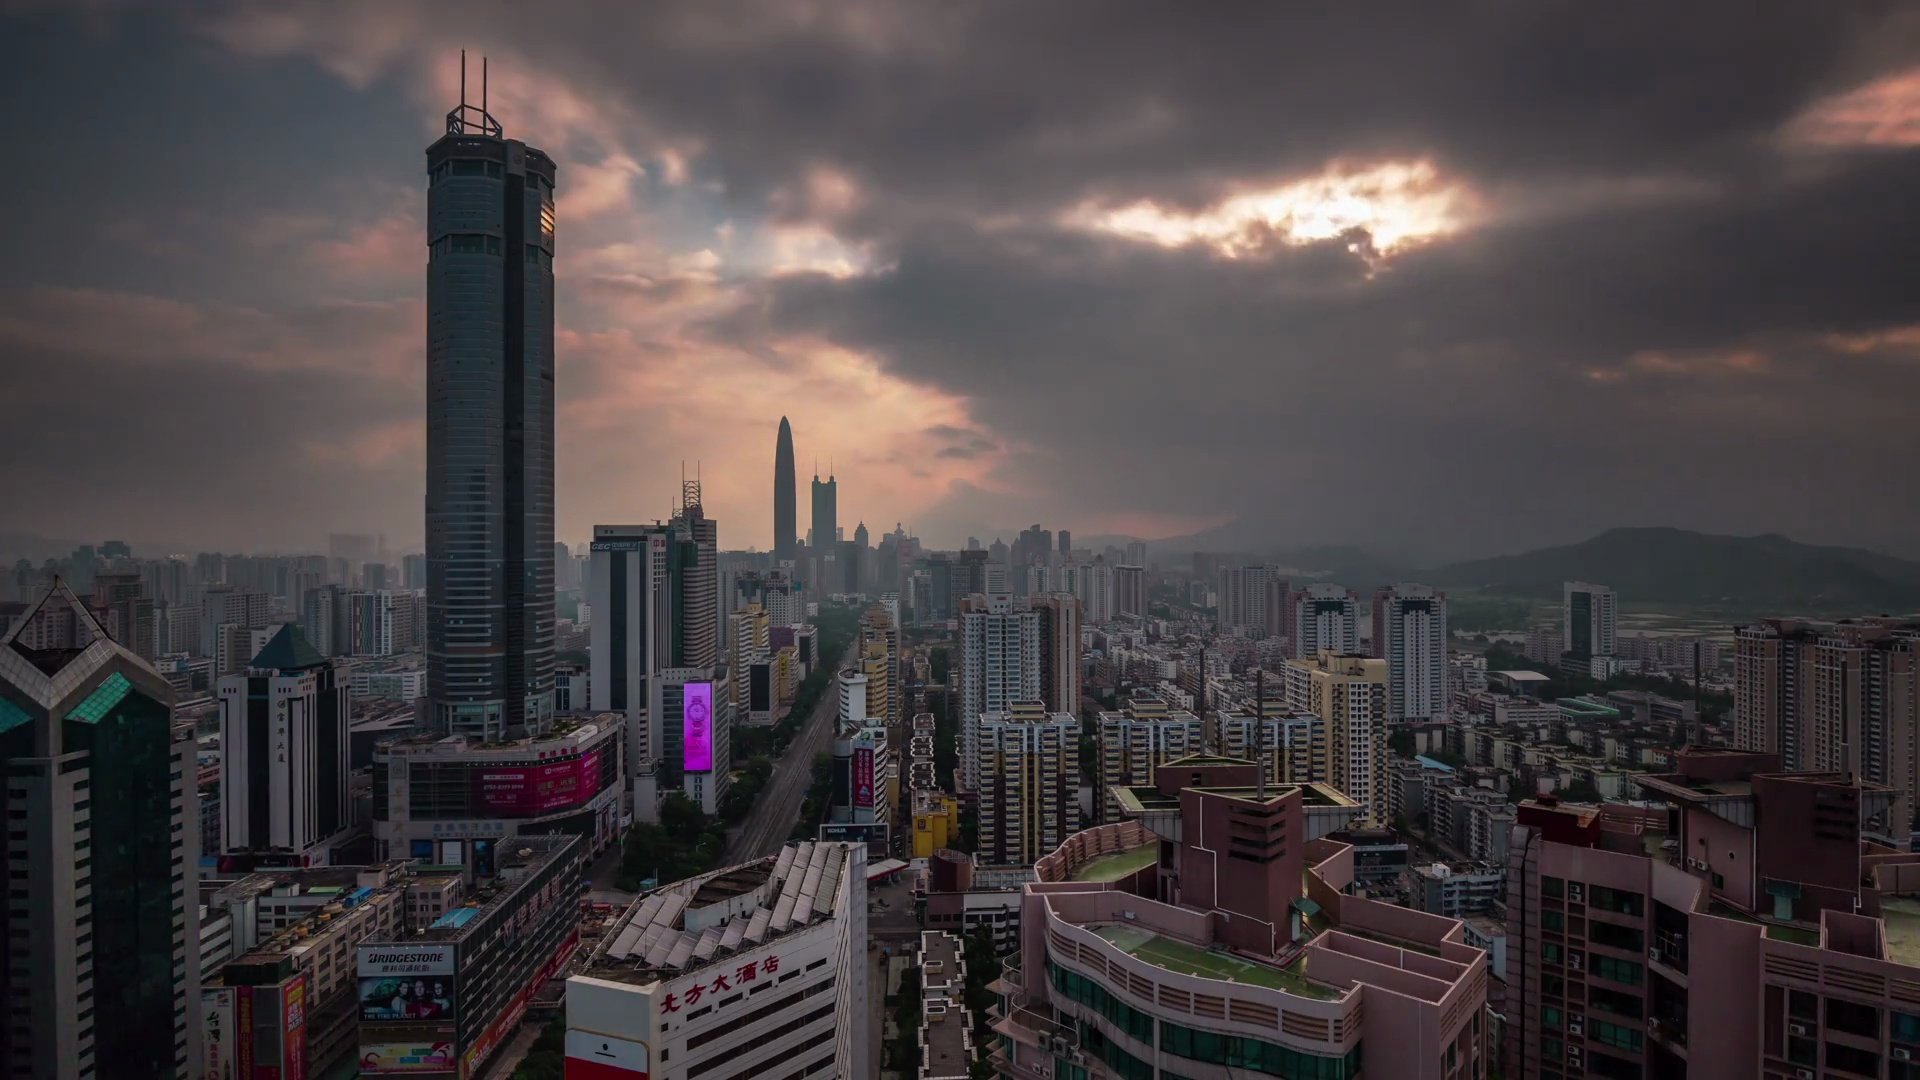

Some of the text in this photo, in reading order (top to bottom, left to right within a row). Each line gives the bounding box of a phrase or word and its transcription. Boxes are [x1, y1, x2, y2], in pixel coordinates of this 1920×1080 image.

[368, 953, 444, 963] BRIDGESTONE
[660, 954, 780, 1014] 北方大酒店
